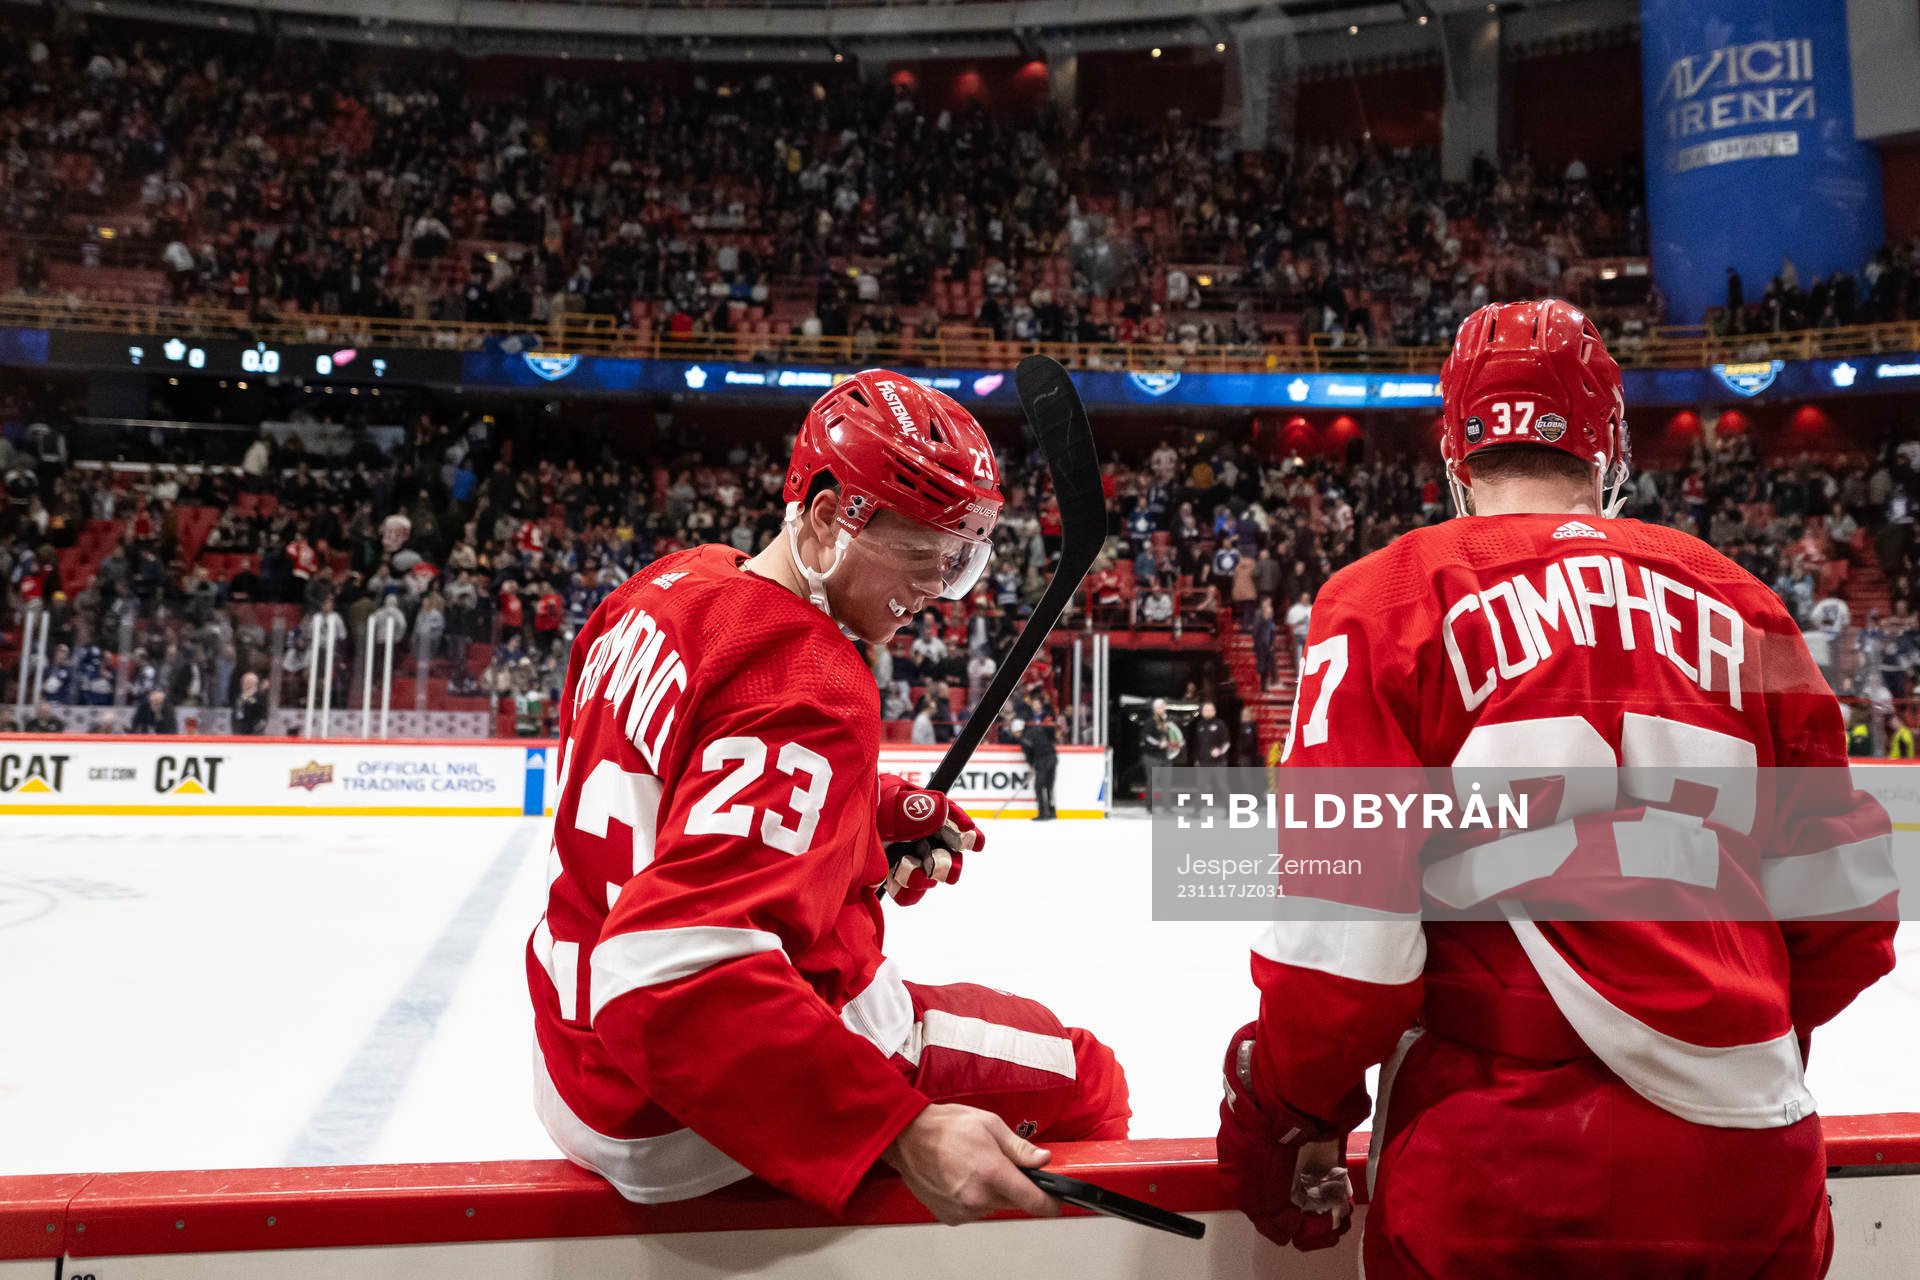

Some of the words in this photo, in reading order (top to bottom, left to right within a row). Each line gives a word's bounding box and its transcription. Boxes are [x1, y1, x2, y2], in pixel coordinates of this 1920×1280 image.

[1657, 38, 1813, 104] AVICII
[874, 380, 917, 437] FASTENAL
[1492, 401, 1535, 436] 37
[968, 447, 994, 481] 23
[965, 503, 998, 518] BAUER
[1552, 529, 1608, 540] adidas
[1443, 555, 1745, 711] COMPHER
[1, 754, 70, 792] CAT
[155, 756, 223, 793] CAT
[342, 777, 426, 791] TRADING
[431, 778, 497, 792] CARDS
[357, 760, 440, 775] OFFICIAL
[446, 760, 481, 775] NHL
[930, 771, 1030, 790] ATION
[684, 735, 833, 857] 23
